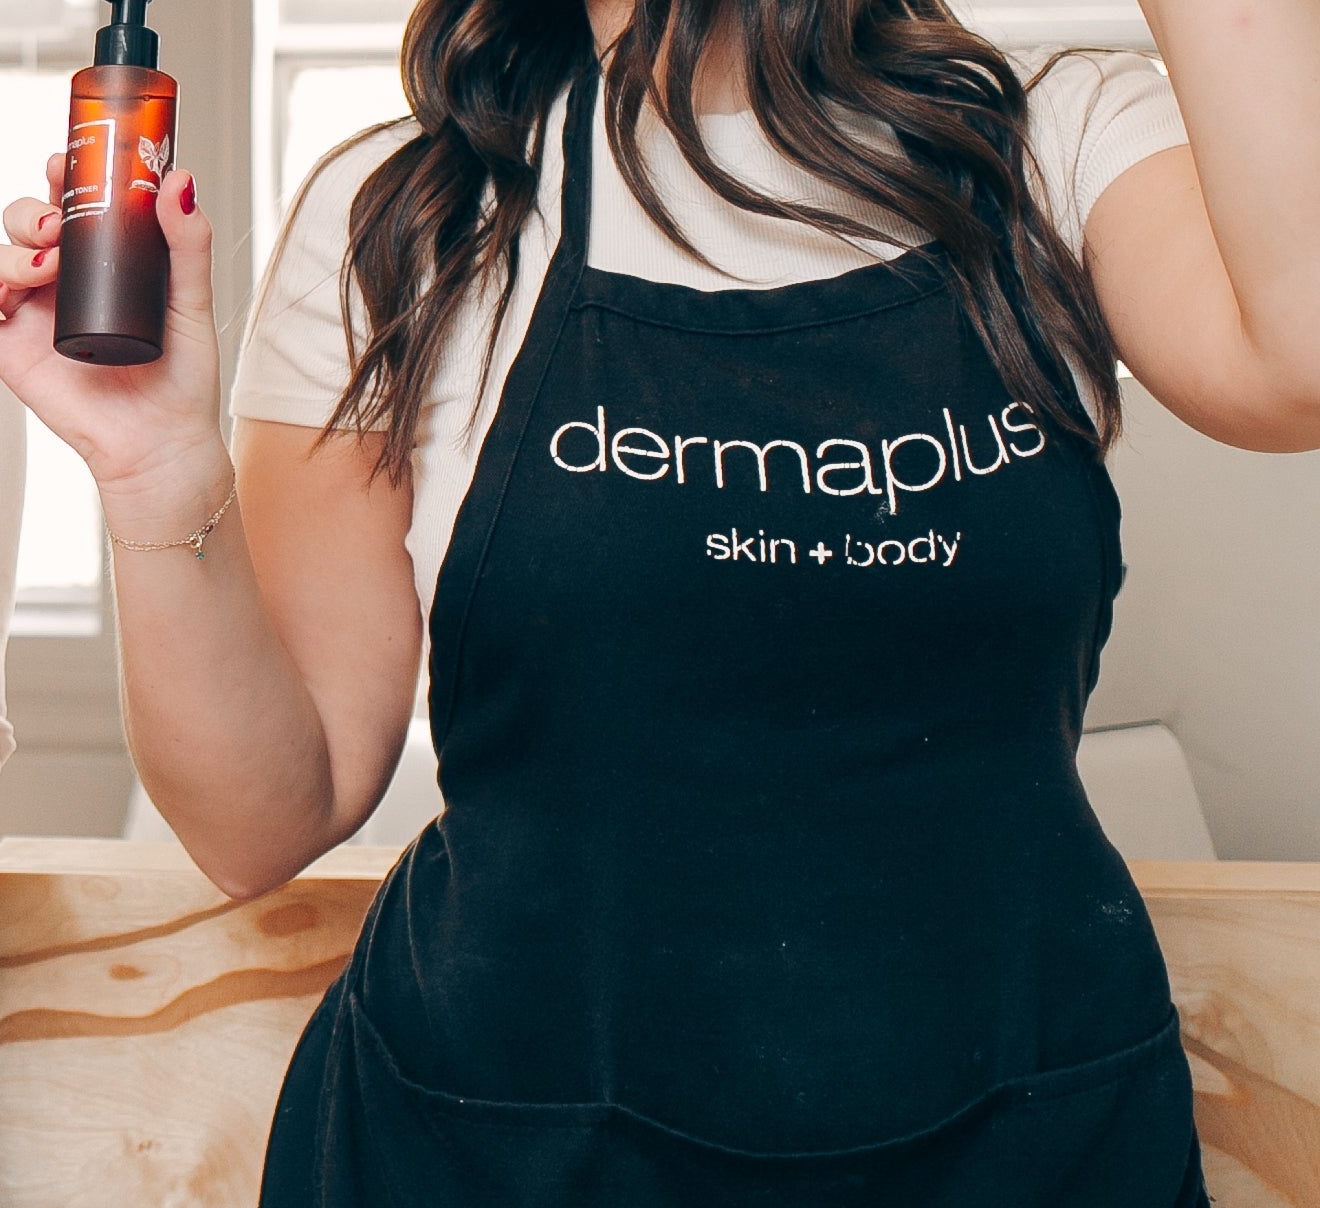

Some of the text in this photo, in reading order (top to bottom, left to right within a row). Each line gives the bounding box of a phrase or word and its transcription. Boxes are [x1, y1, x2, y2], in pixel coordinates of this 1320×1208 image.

[75, 185, 99, 195] TONER
[550, 401, 1046, 516] dermaplus
[706, 528, 797, 565] skin
[844, 529, 961, 567] body
